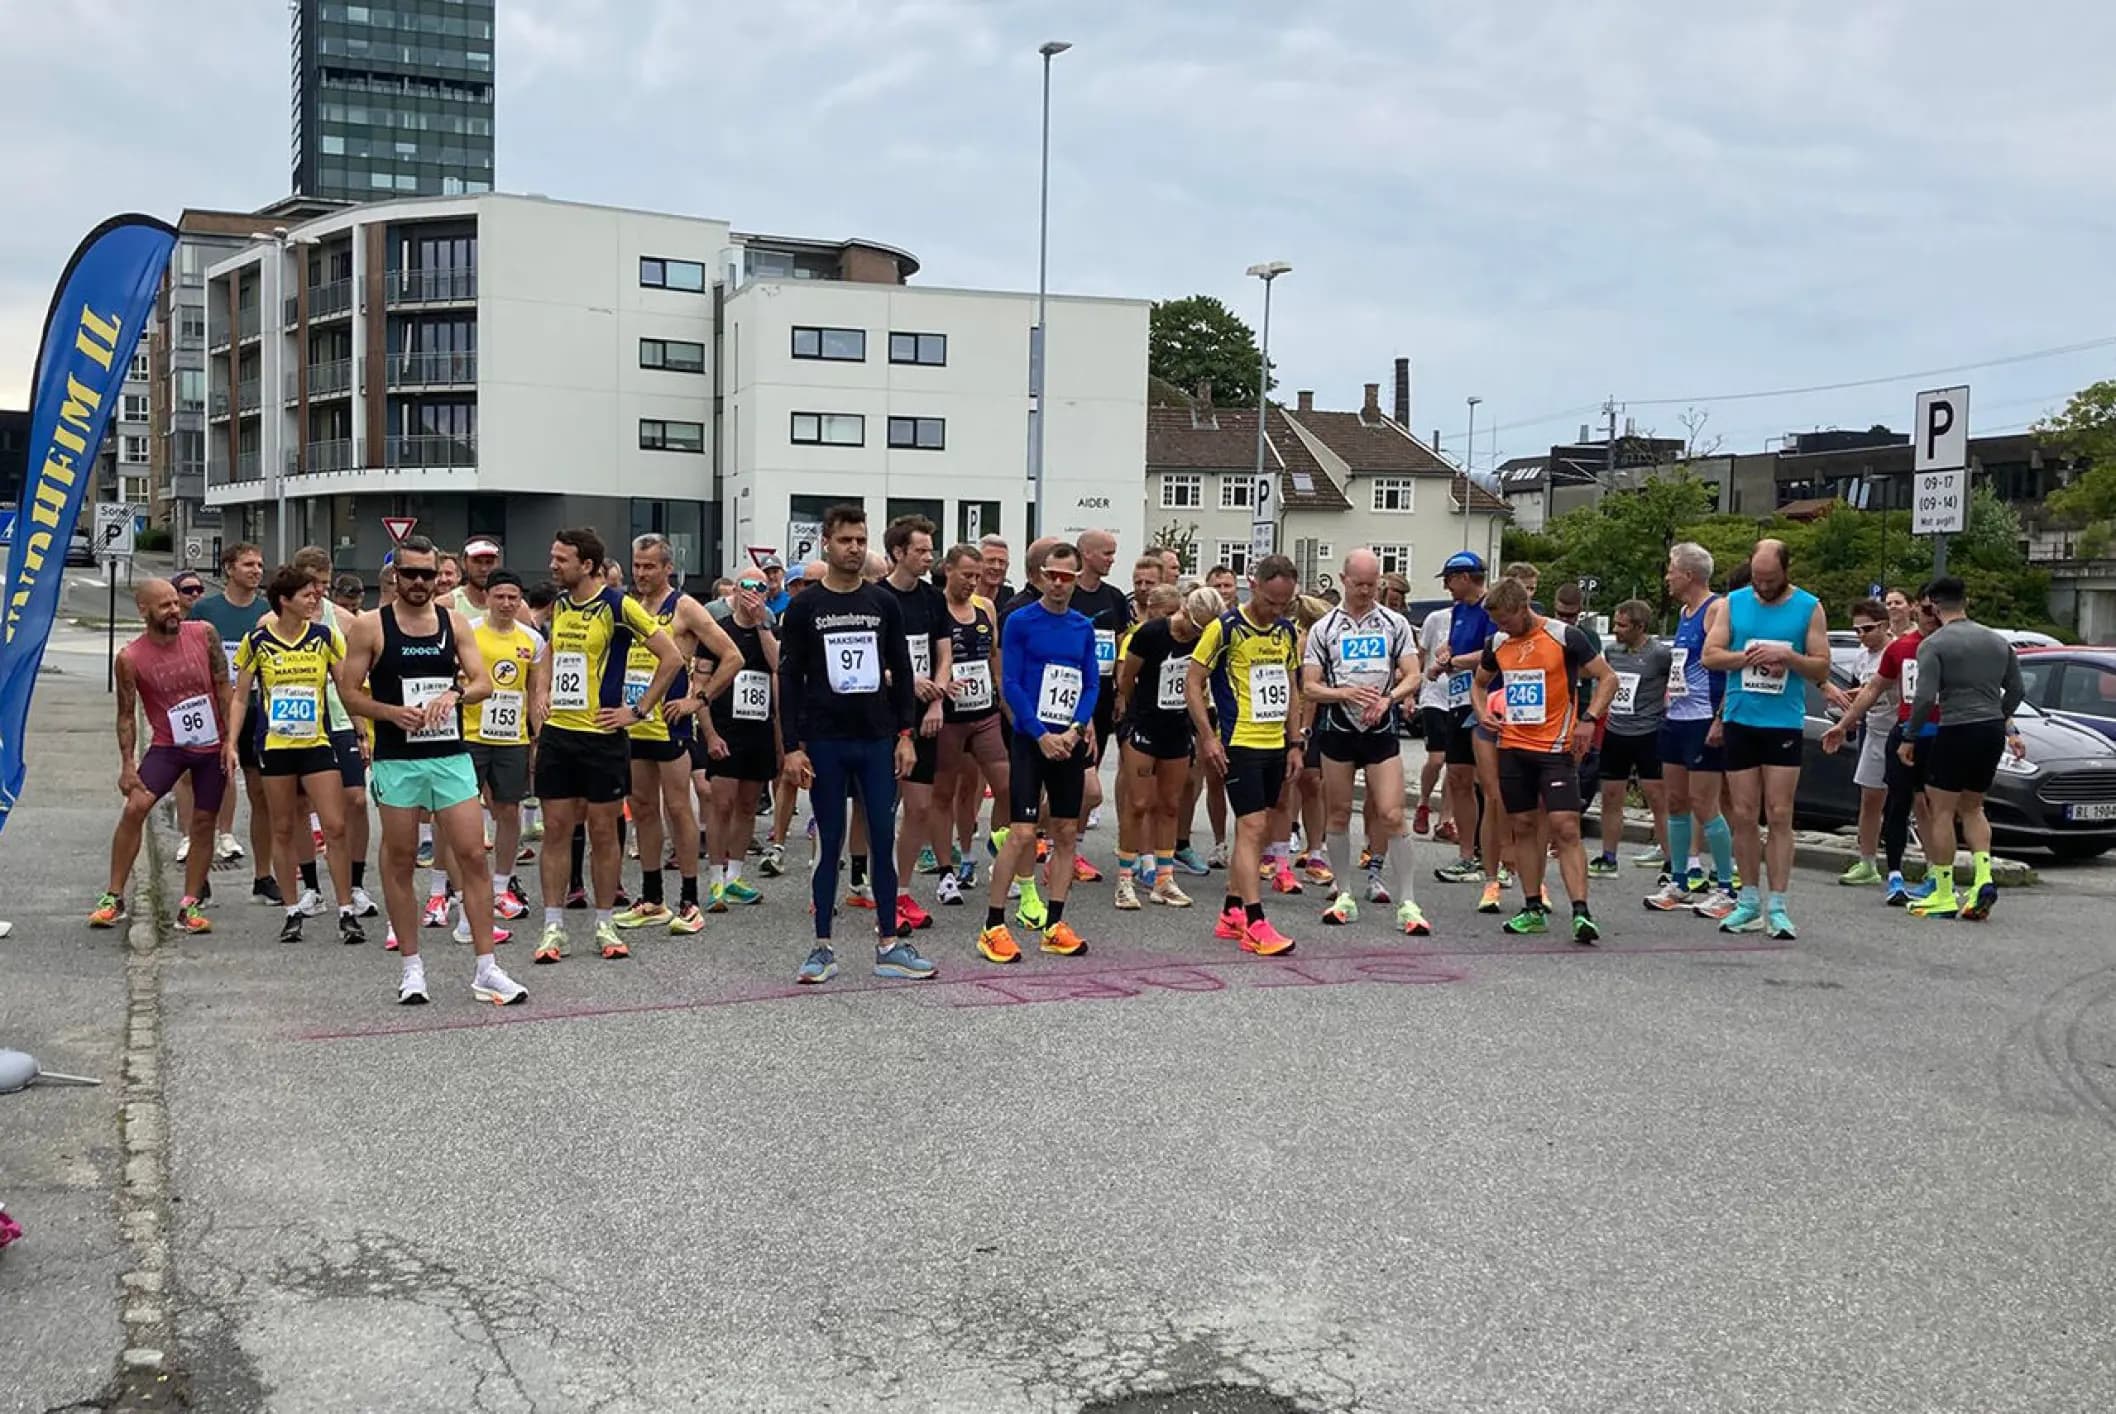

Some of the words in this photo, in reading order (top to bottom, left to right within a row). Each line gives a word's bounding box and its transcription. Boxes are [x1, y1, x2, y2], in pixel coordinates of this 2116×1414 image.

[76, 304, 122, 373] IL
[1927, 401, 1954, 460] P
[1077, 498, 1111, 509] AIDER
[1258, 479, 1270, 516] P
[970, 510, 978, 530] P
[105, 524, 122, 546] P
[799, 540, 812, 561] P
[815, 612, 881, 630] Schlumberger
[828, 635, 873, 645] MAKSIMER
[1347, 637, 1381, 658] 242
[841, 649, 864, 671] 97
[556, 672, 580, 692] 182
[741, 688, 767, 706] 186
[1050, 686, 1078, 710] 145
[1259, 685, 1286, 705] 195
[1508, 684, 1538, 704] 246
[277, 700, 310, 719] 240
[490, 707, 517, 725] 153
[182, 711, 203, 731] 96
